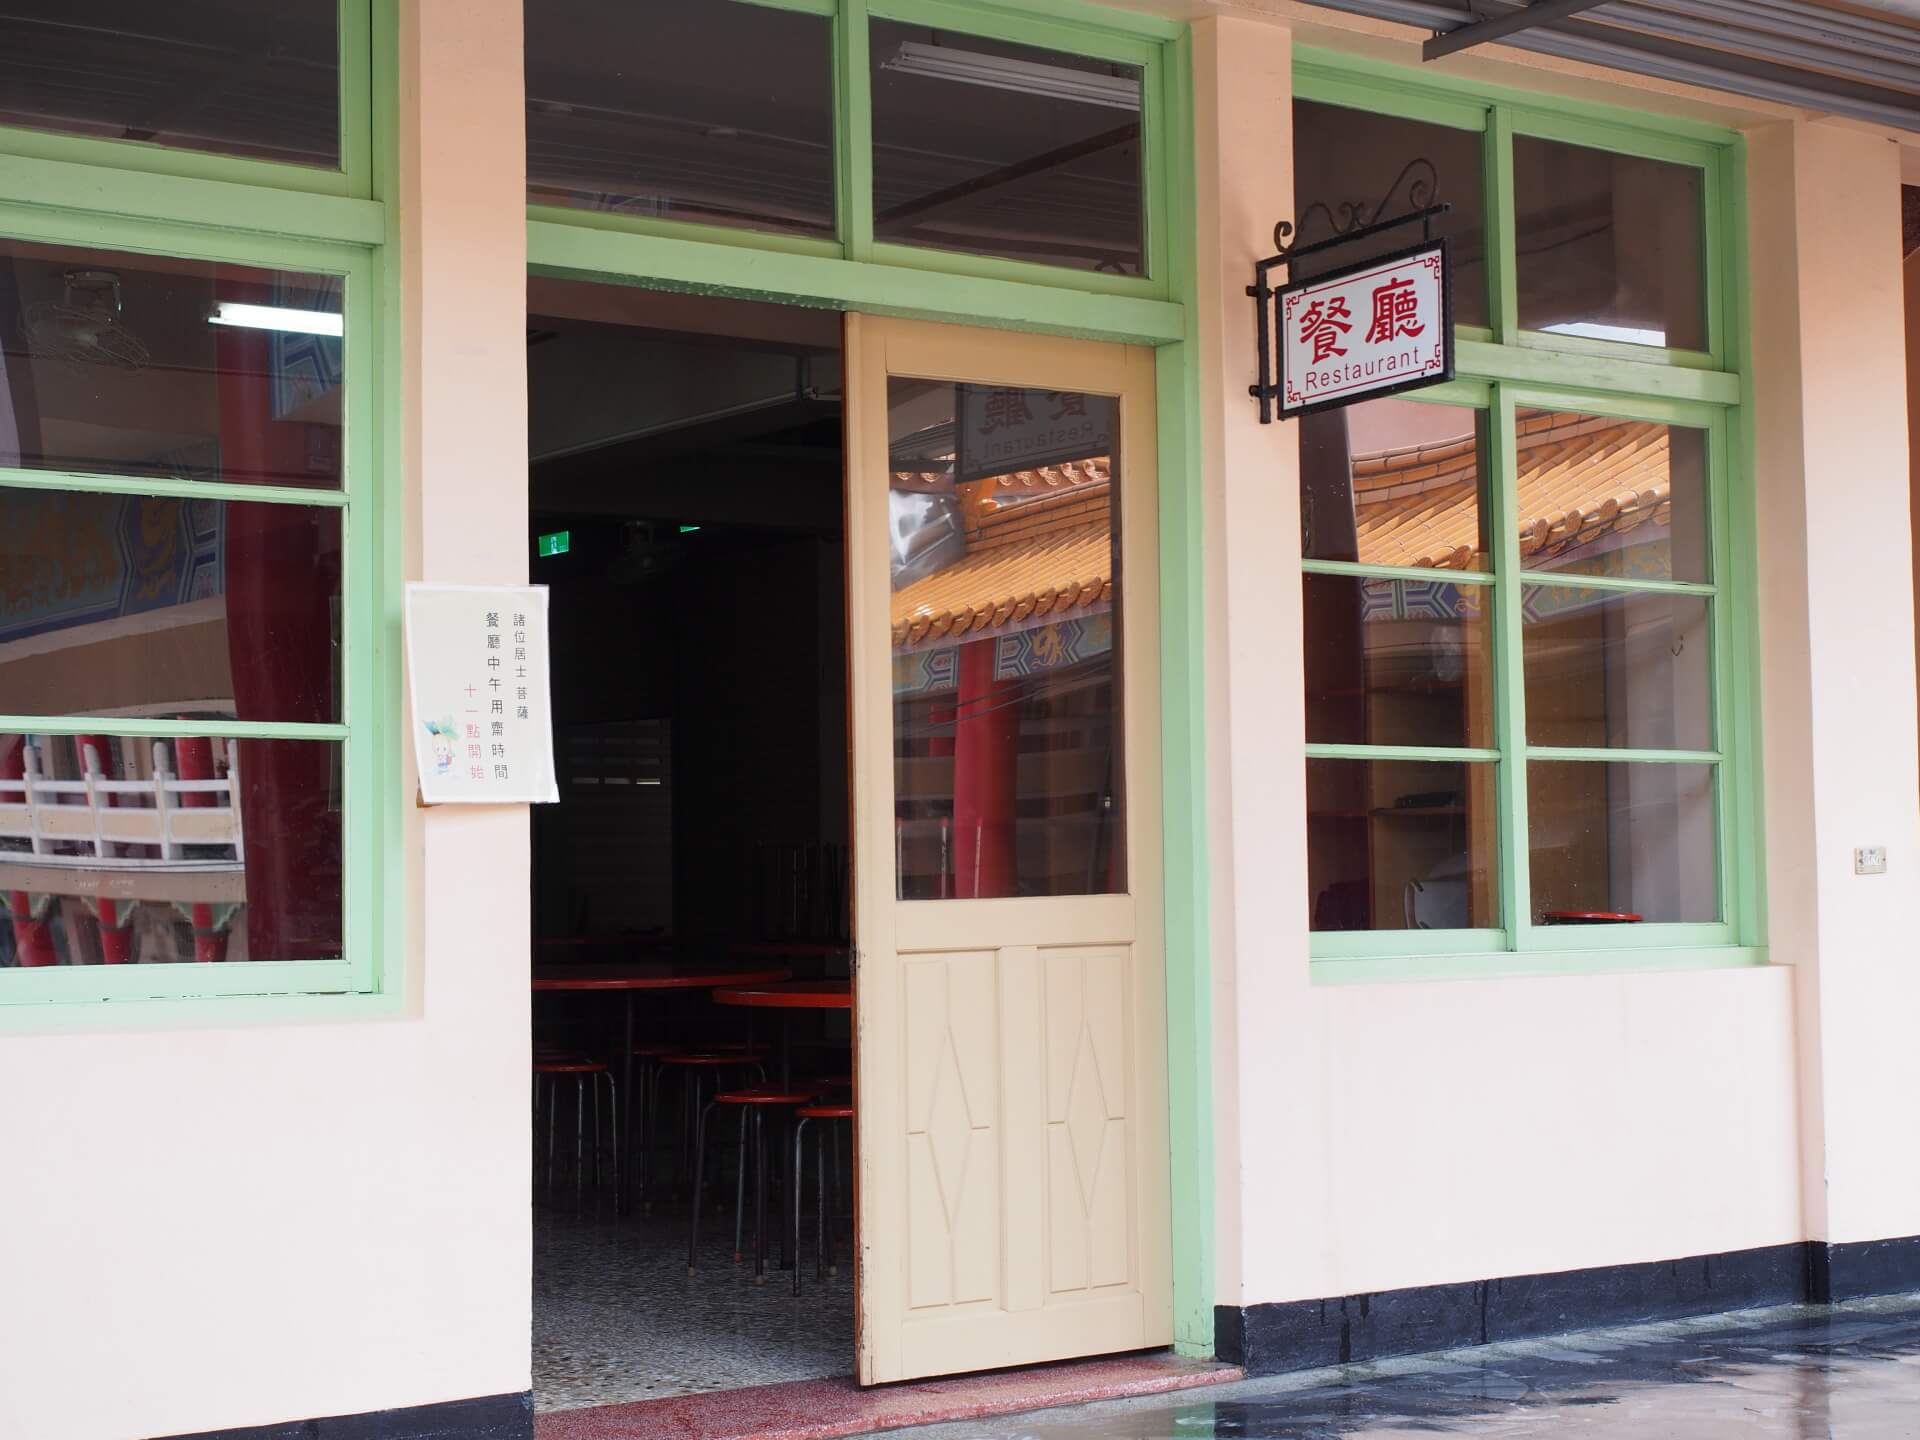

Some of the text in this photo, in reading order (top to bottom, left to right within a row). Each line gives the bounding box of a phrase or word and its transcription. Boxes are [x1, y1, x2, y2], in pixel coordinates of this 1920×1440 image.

[1299, 277, 1426, 365] 餐廳
[1305, 346, 1420, 392] Restaurant
[486, 612, 508, 779] 餐廳中午用齋時間
[513, 613, 528, 719] 諸位居士菩薩
[464, 684, 484, 779] 十一點開始
